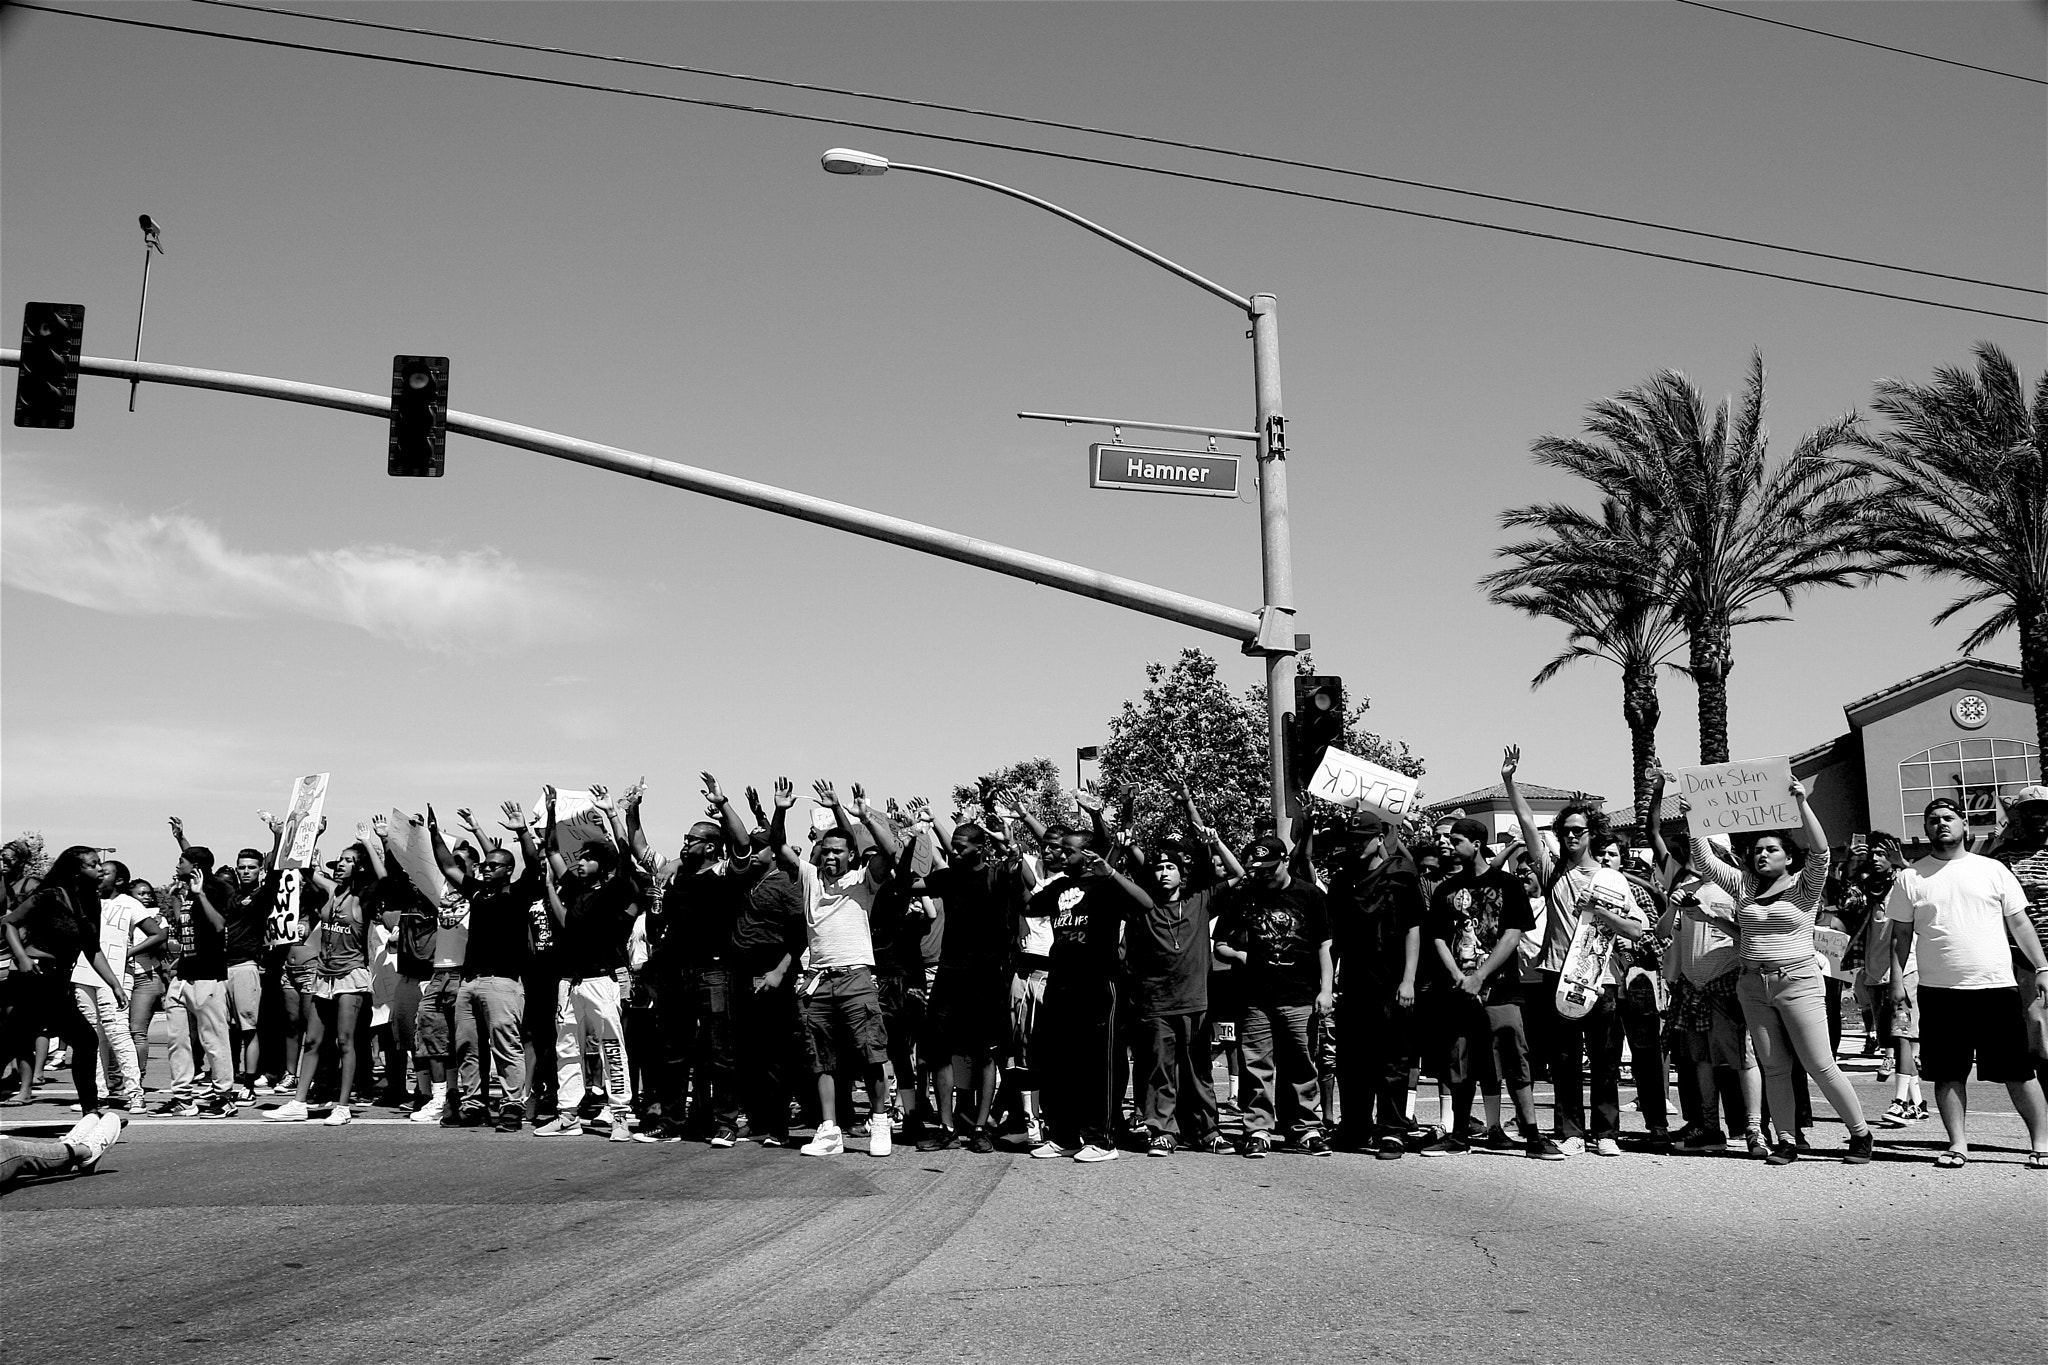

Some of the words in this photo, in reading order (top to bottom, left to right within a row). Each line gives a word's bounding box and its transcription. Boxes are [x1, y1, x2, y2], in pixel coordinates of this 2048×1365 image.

[1127, 458, 1210, 483] Hamner
[1323, 764, 1407, 815] BLACK
[1685, 773, 1726, 794] Dark
[1727, 769, 1768, 787] Skin
[1707, 797, 1719, 807] is
[1725, 789, 1763, 806] NOT
[1702, 818, 1711, 828] a
